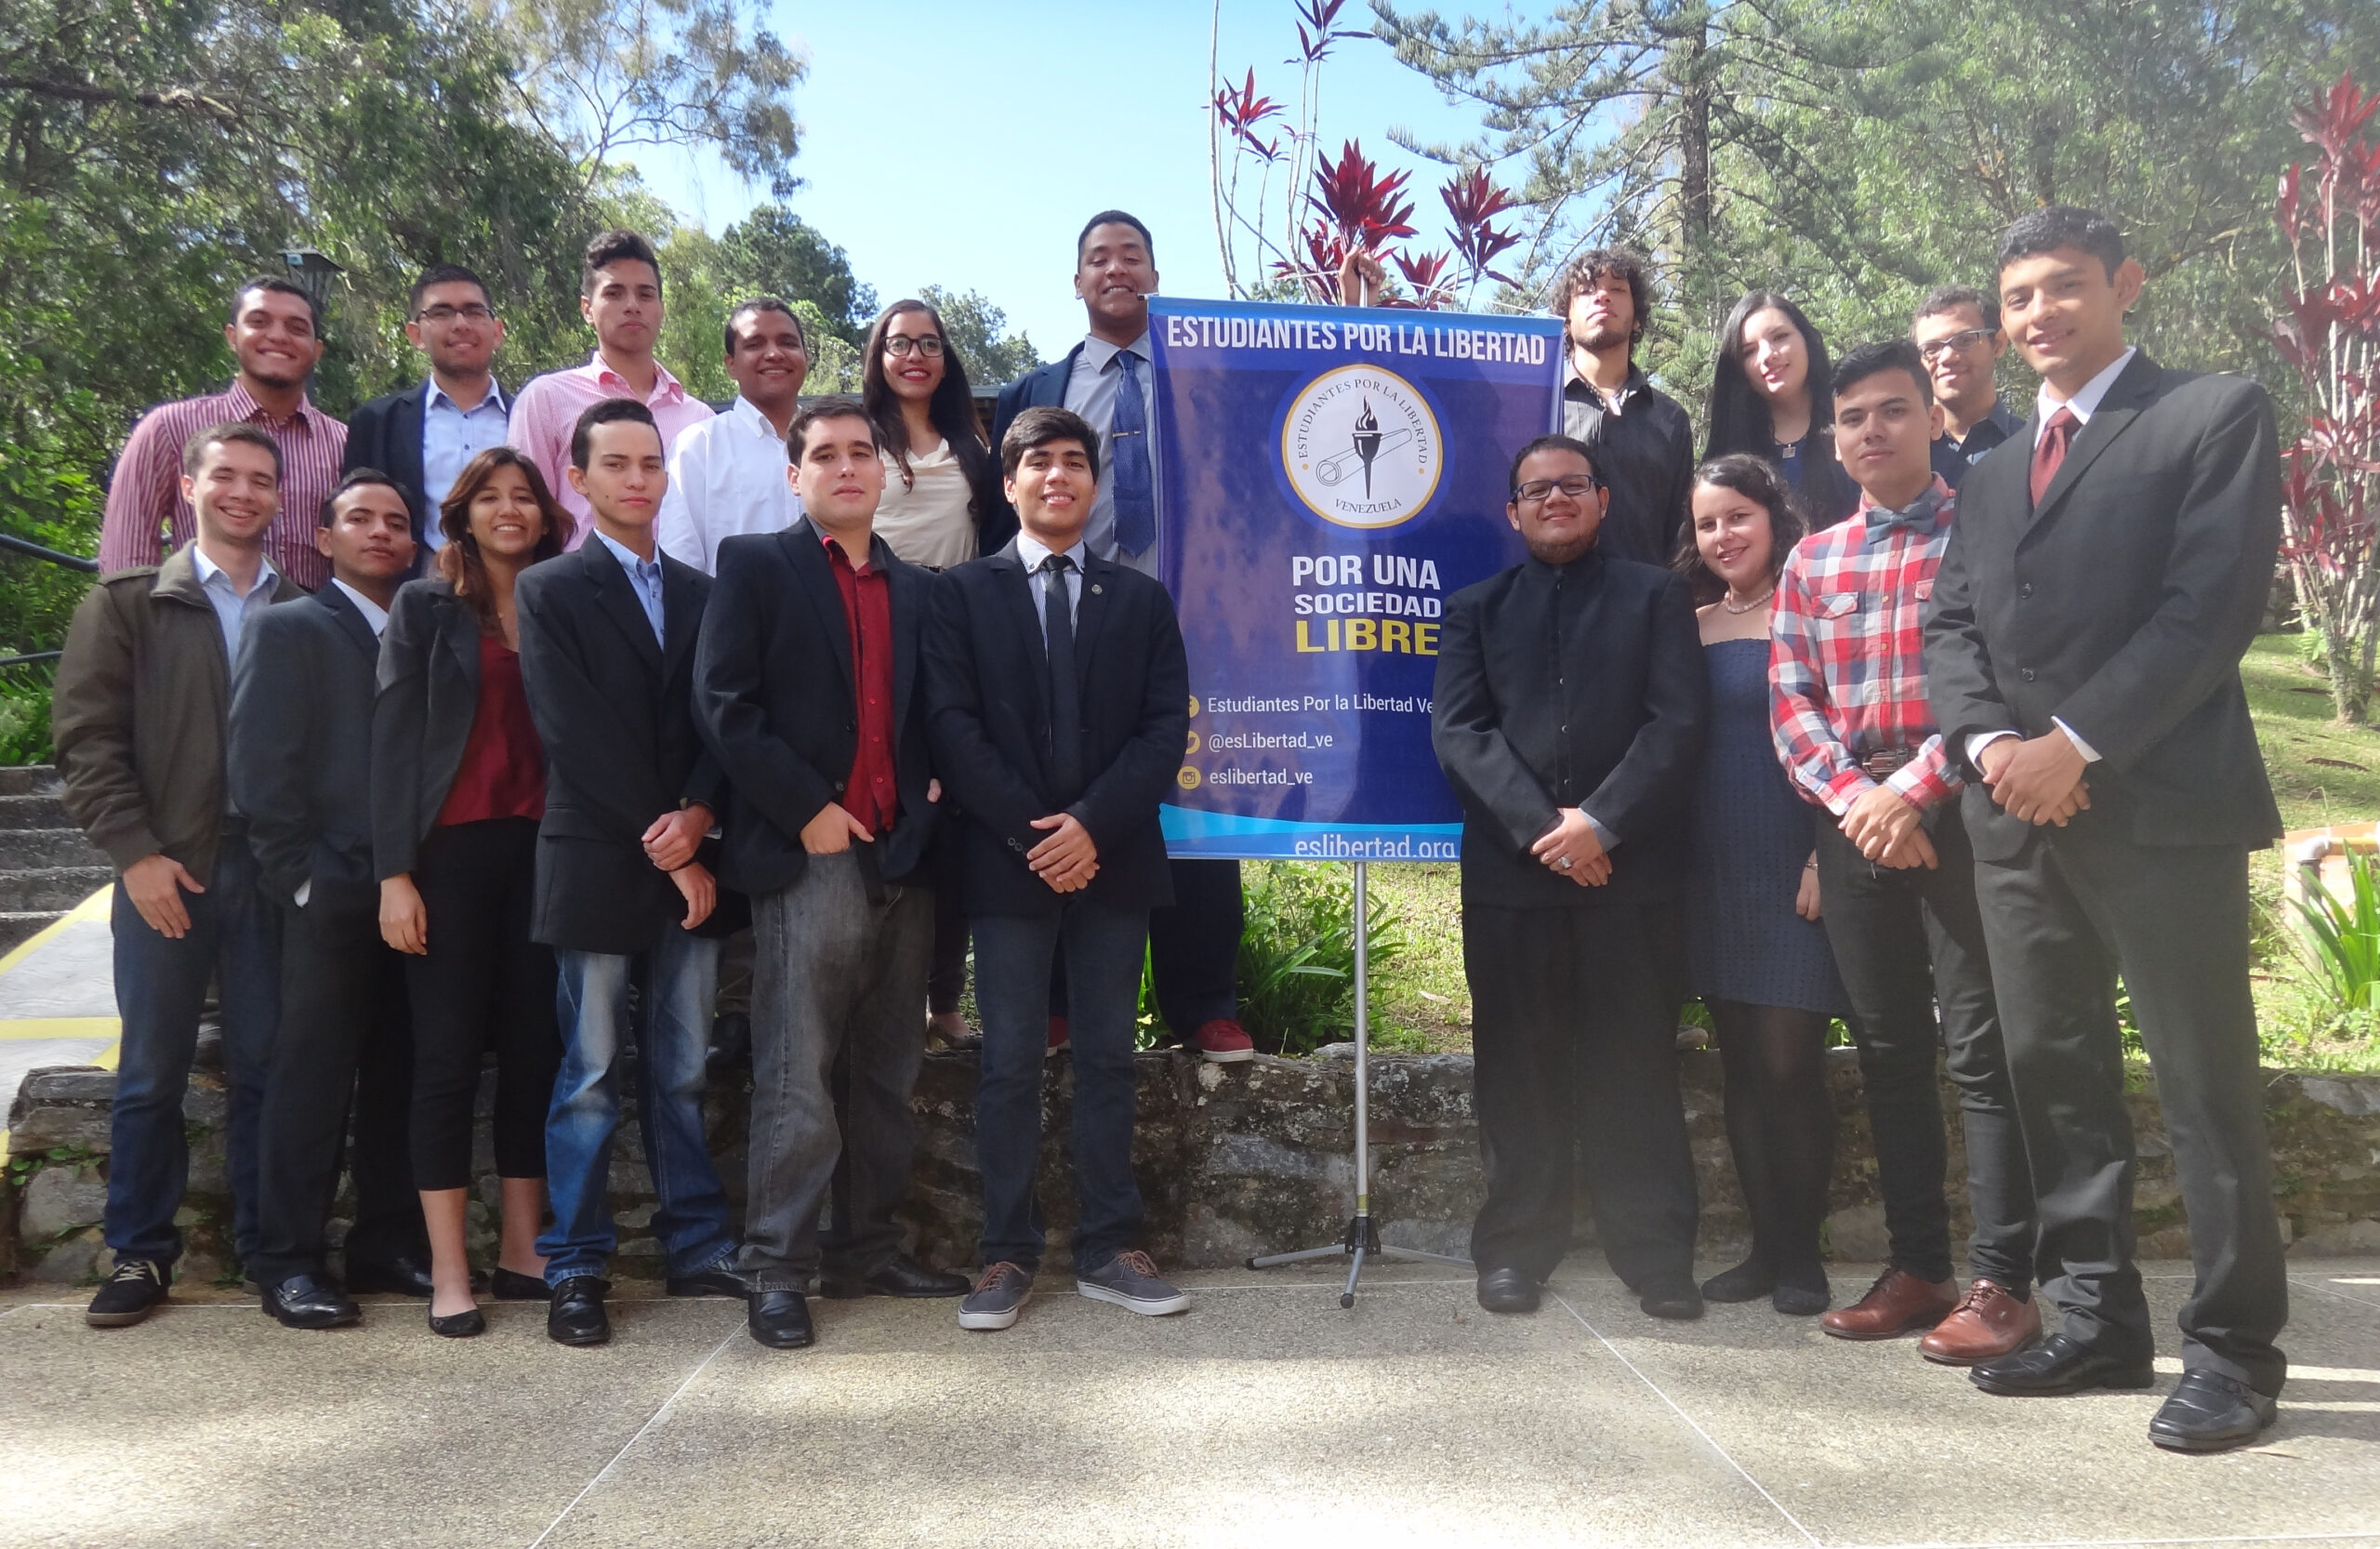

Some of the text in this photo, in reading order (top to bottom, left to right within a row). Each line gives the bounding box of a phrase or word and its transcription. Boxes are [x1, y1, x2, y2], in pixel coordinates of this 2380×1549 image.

[1167, 315, 1546, 365] ESTUDIANTES POR LA LIBERTAD
[1298, 378, 1428, 464] ESTUDIANTES POR LA LIBERTAD
[1335, 498, 1402, 513] VENEZUELA
[1291, 554, 1441, 590] POR UNA
[1294, 592, 1442, 618] SOCIEDAD
[1295, 617, 1441, 655] LIBRE
[1208, 695, 1299, 713] Estudiantes
[1303, 695, 1329, 712] Por
[1335, 695, 1349, 710] la
[1354, 694, 1413, 713] Libertad
[1209, 732, 1333, 753] @esLibertad_ve
[1210, 768, 1314, 786] eslibertad_ve
[1295, 833, 1456, 858] eslibertad.org
